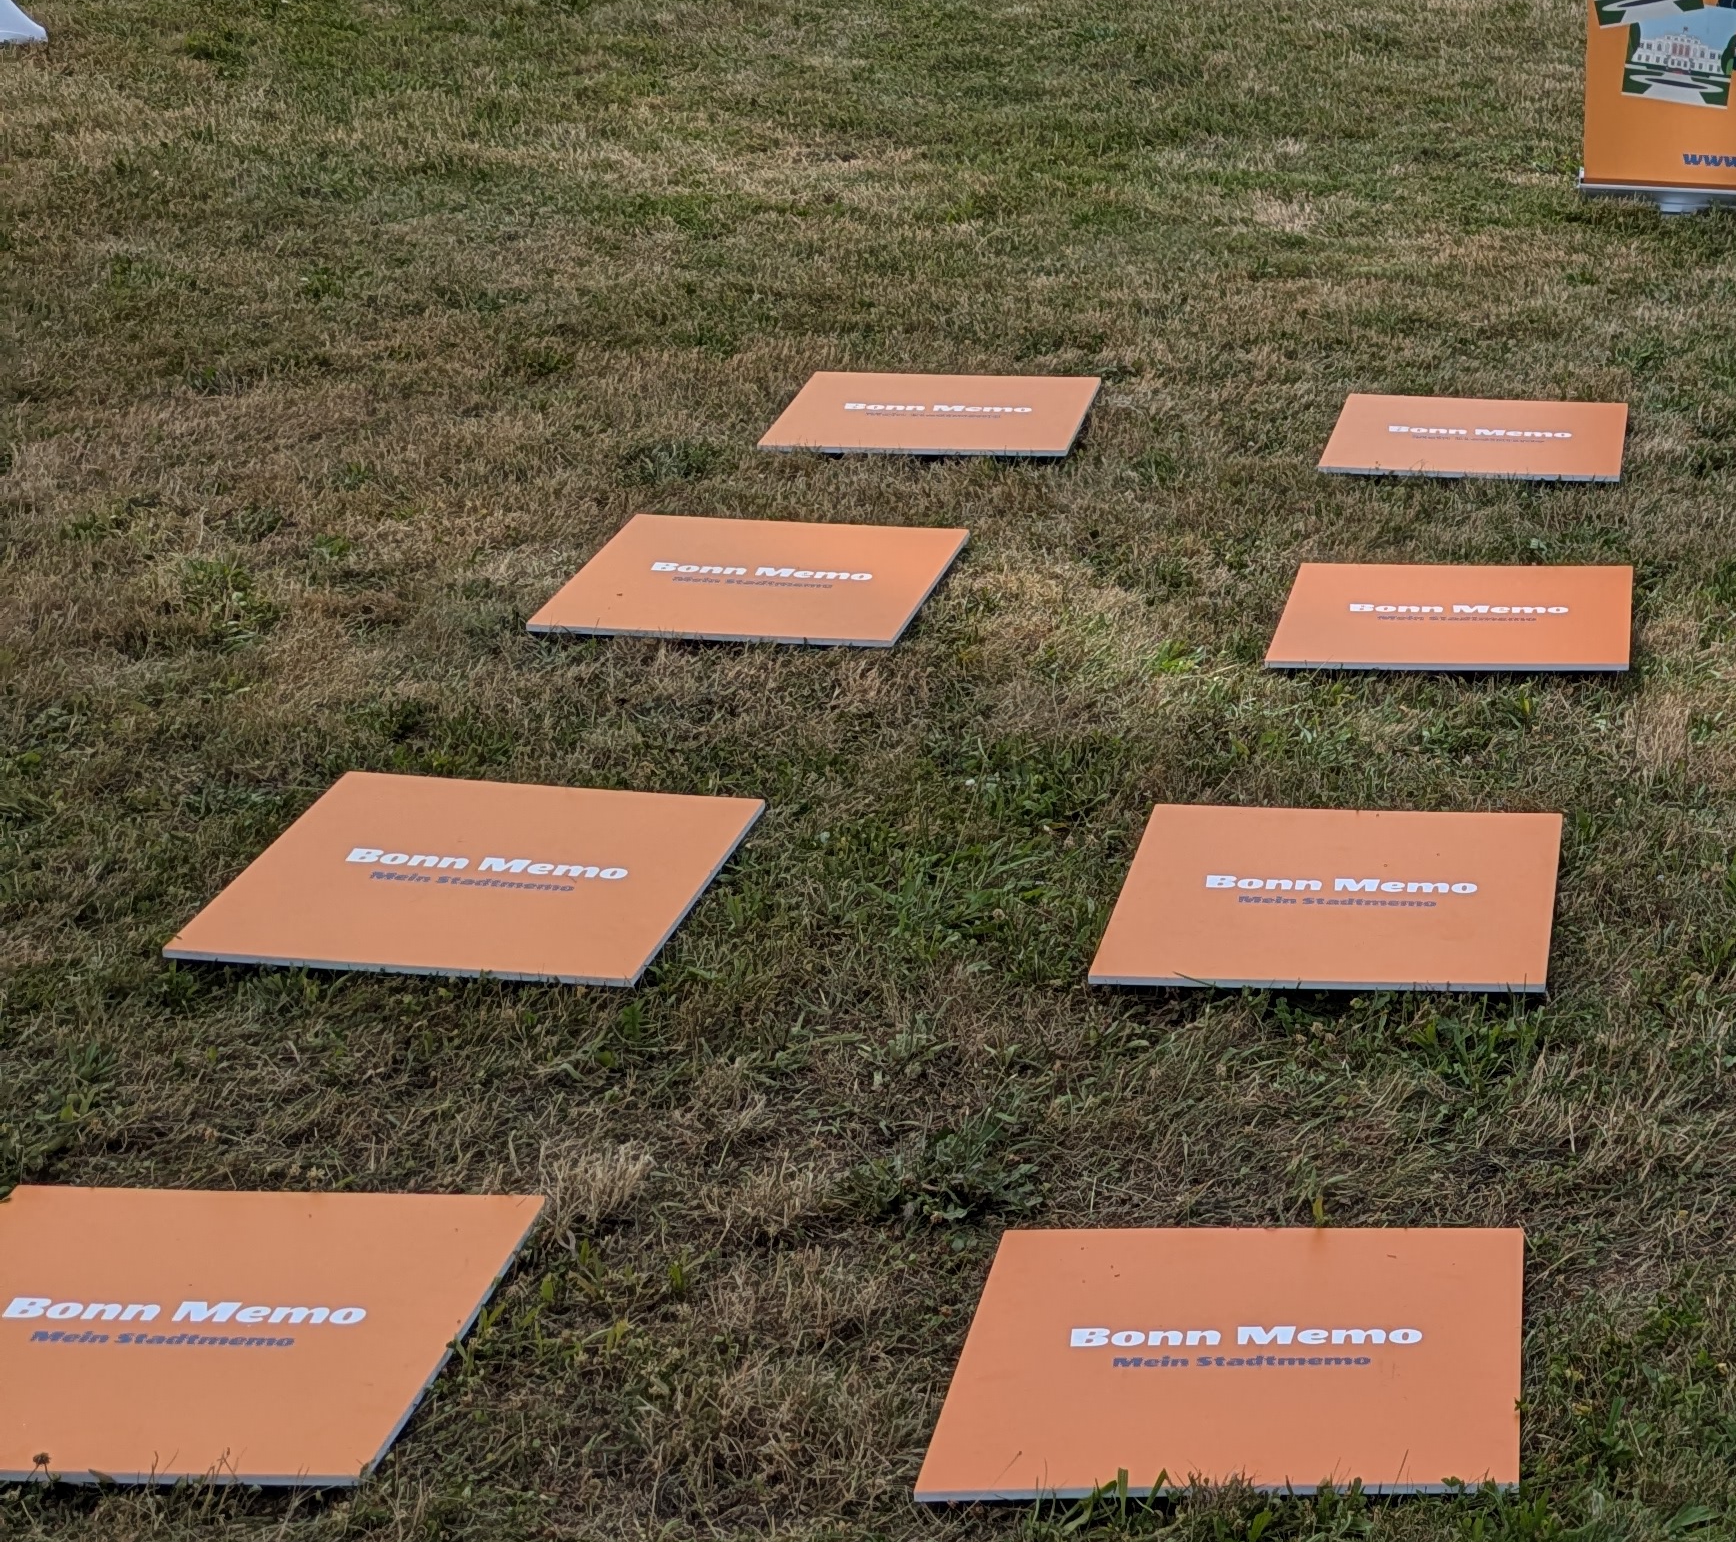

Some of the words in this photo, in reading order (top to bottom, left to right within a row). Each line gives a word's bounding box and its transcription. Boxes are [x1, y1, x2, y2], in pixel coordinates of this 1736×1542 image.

[844, 402, 926, 412] Bonn
[932, 404, 1032, 414] Memo
[1388, 425, 1468, 436] Bonn
[1474, 428, 1573, 439] Memo
[650, 561, 747, 576] Bonn
[754, 566, 874, 582] Memo
[1349, 603, 1444, 614] Bonn
[1452, 604, 1570, 615] Memo
[345, 848, 470, 870] Bonn
[477, 857, 629, 880] Memo
[1205, 875, 1323, 891] Bonn
[1333, 878, 1479, 894] Memo
[2, 1297, 162, 1321] Bonn
[171, 1301, 367, 1325] Memo
[1069, 1328, 1223, 1347] Bonn
[1236, 1326, 1424, 1345] Memo
